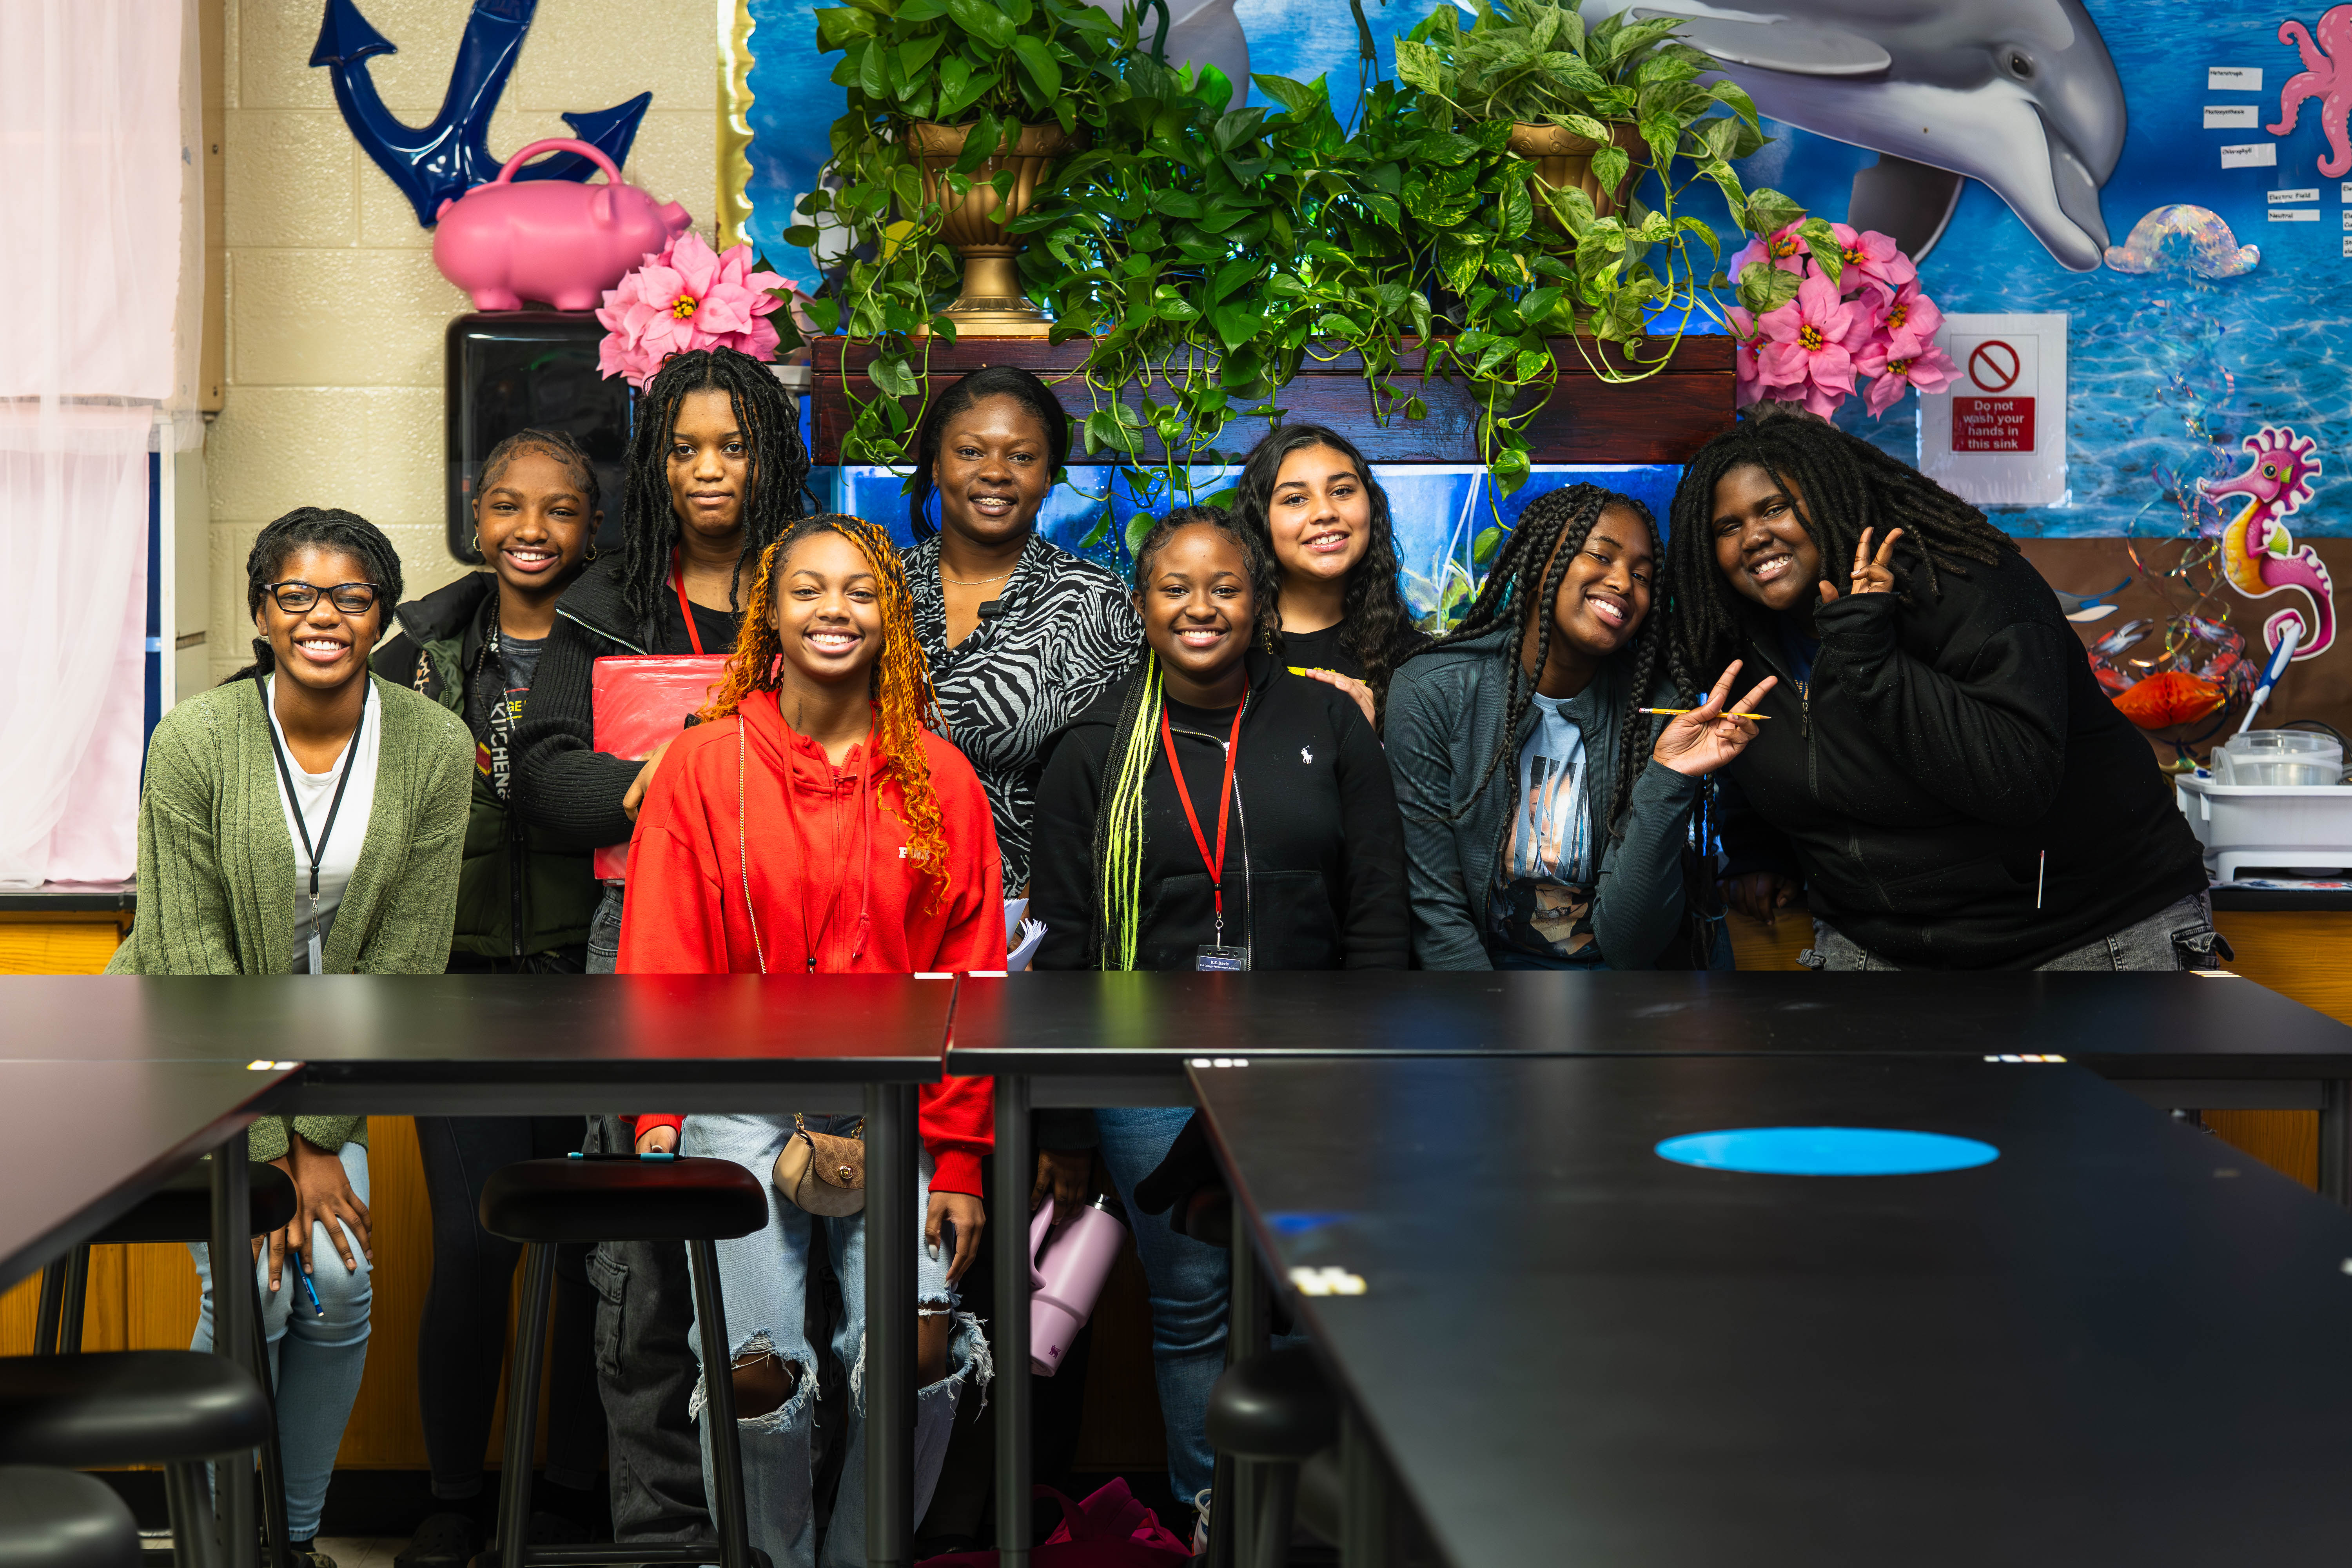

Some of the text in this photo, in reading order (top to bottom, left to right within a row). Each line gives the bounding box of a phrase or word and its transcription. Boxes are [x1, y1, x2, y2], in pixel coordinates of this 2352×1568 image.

[1974, 400, 2014, 411] Do not
[1963, 413, 2025, 426] wash your
[1968, 425, 2018, 436] hands in
[1968, 438, 2018, 449] this sink
